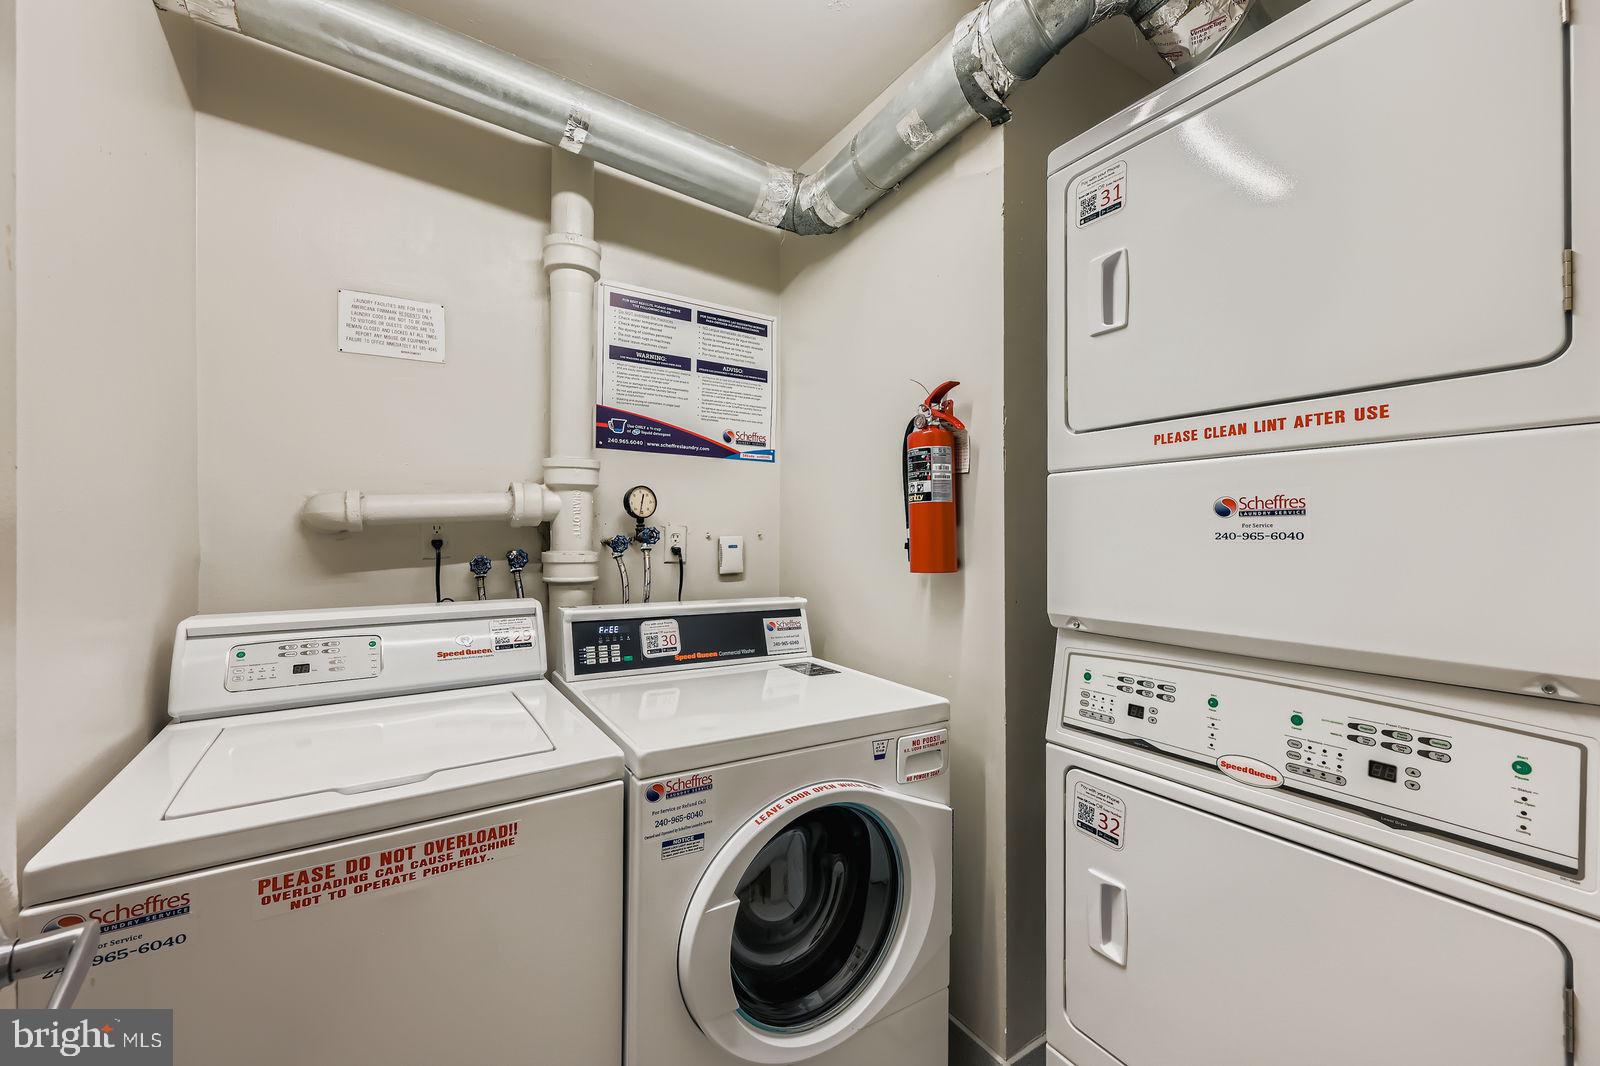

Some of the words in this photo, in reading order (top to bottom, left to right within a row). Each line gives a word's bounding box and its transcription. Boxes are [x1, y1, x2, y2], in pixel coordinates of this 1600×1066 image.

[1190, 24, 1213, 36] Venture
[1213, 18, 1226, 28] Tape
[1100, 183, 1122, 207] 31
[1153, 429, 1198, 446] PLEASE
[1204, 422, 1247, 439] CLEAN
[1254, 418, 1287, 433] LINT
[1294, 410, 1346, 428] AFTER
[1354, 404, 1390, 422] USE
[607, 438, 644, 446] 240.965.6040
[646, 442, 710, 452] www.scheffreslaundry.com
[736, 430, 766, 442] Scheffres
[1238, 494, 1306, 510] Scheffres
[1214, 532, 1304, 540] 240-965-6040
[661, 633, 676, 646] 30
[436, 650, 464, 659] Speed
[466, 648, 492, 656] Queen
[674, 652, 696, 662] Speed
[697, 651, 718, 660] Queen
[718, 649, 741, 658] Commercial
[912, 739, 920, 747] NO
[914, 772, 930, 781] POWDER
[1220, 760, 1248, 774] Speed
[1248, 767, 1278, 782] Queen
[666, 774, 713, 793] Scheffres
[660, 806, 676, 814] Service
[682, 800, 698, 810] Refund
[754, 804, 784, 826] LEAVE
[785, 790, 812, 805] DOOR
[812, 783, 837, 794] OPEN
[654, 810, 704, 828] 240-965-6040
[1098, 812, 1120, 837] 32
[672, 836, 694, 844] NOTICE
[257, 864, 336, 896] PLEASE
[346, 856, 371, 875] DO
[380, 845, 416, 866] NOT
[424, 822, 518, 856] OVERLOAD!!
[260, 874, 368, 906] OVERLOADING
[374, 864, 404, 879] CAN
[410, 852, 454, 871] CAUSE
[460, 837, 516, 858] MACHINE
[290, 894, 320, 911] NOT
[328, 888, 347, 902] TO
[354, 871, 416, 895] OPERATE
[88, 892, 190, 925] Scheffres
[101, 918, 140, 932] UNDRY
[145, 907, 190, 922] SERVICE
[98, 940, 108, 950] or
[110, 933, 143, 947] Service
